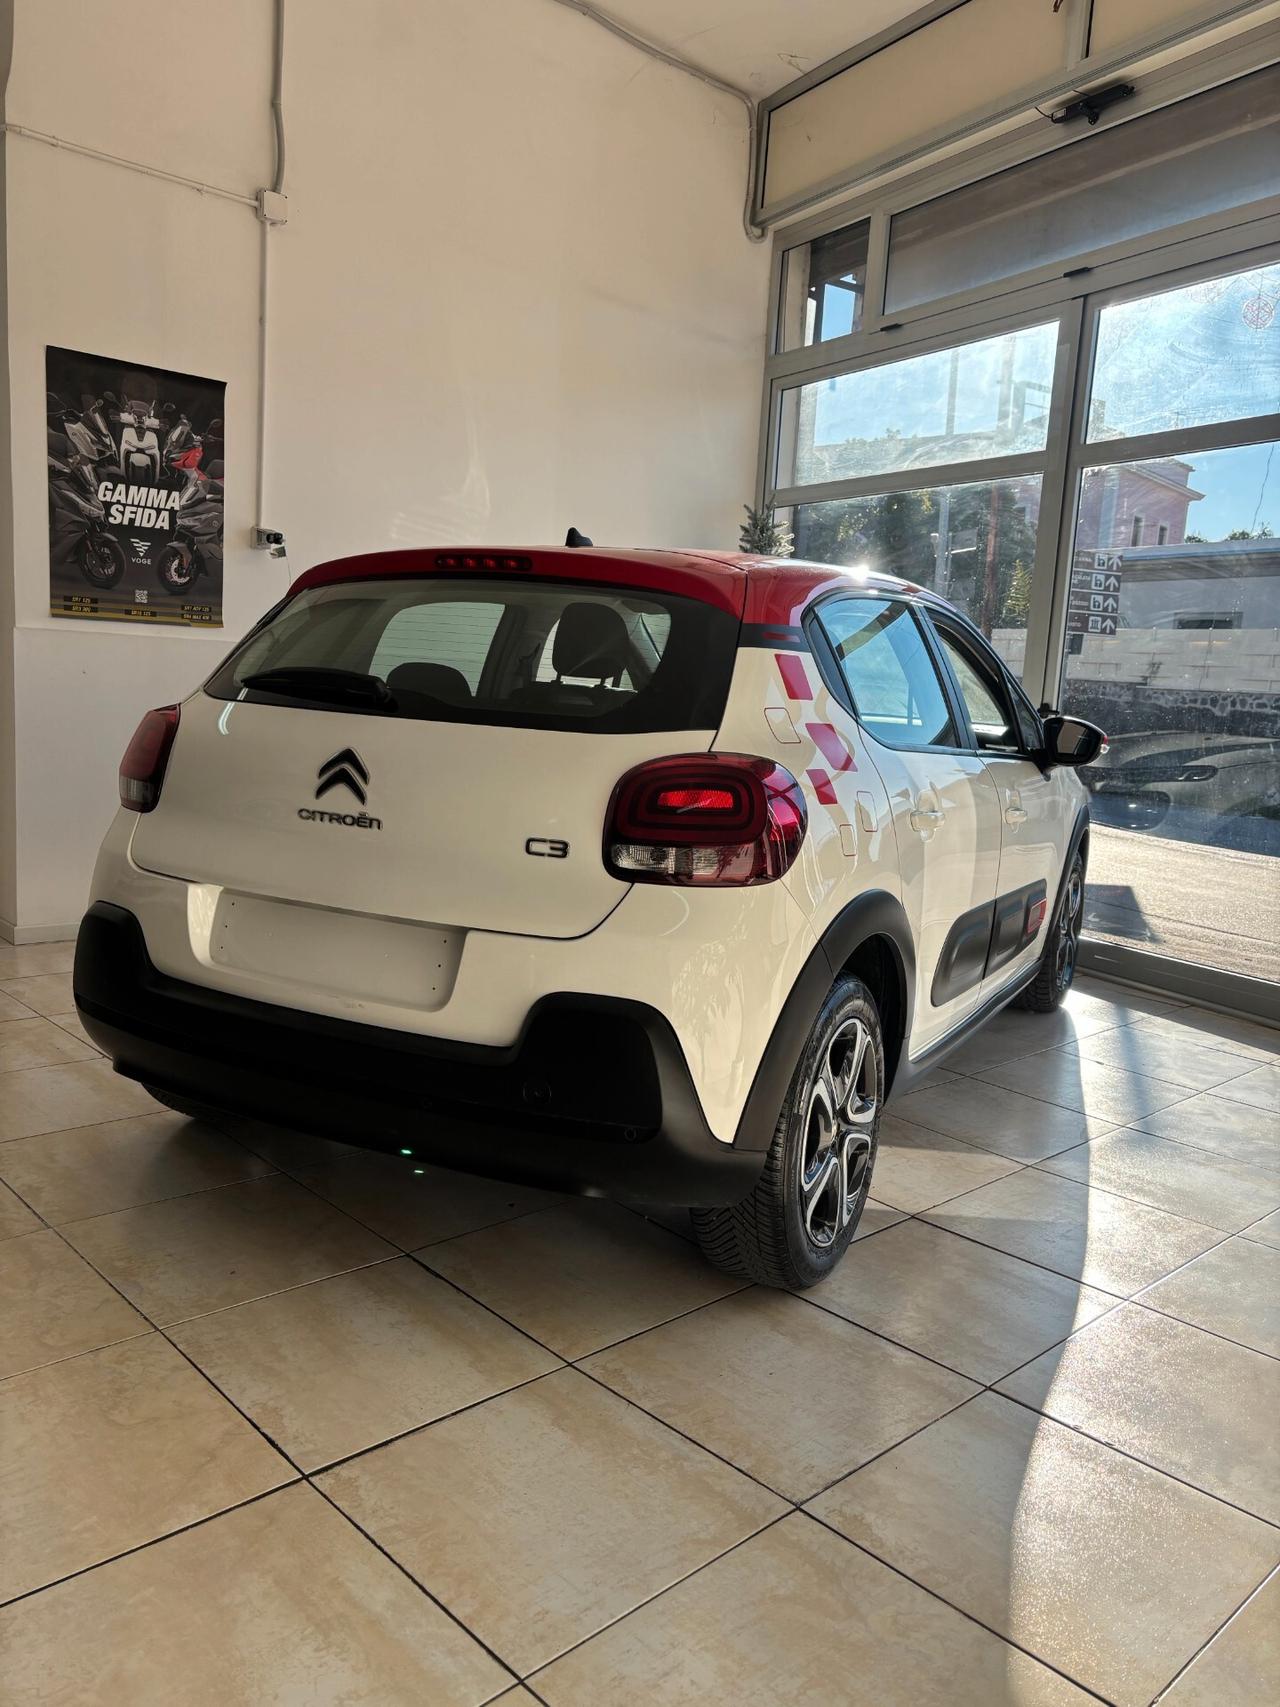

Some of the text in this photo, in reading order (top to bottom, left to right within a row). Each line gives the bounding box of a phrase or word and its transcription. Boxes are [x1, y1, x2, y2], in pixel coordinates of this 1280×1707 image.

[97, 481, 181, 511] GAMMA
[108, 504, 170, 530] SFIDA
[131, 557, 152, 565] VOGE
[525, 837, 570, 859] C3
